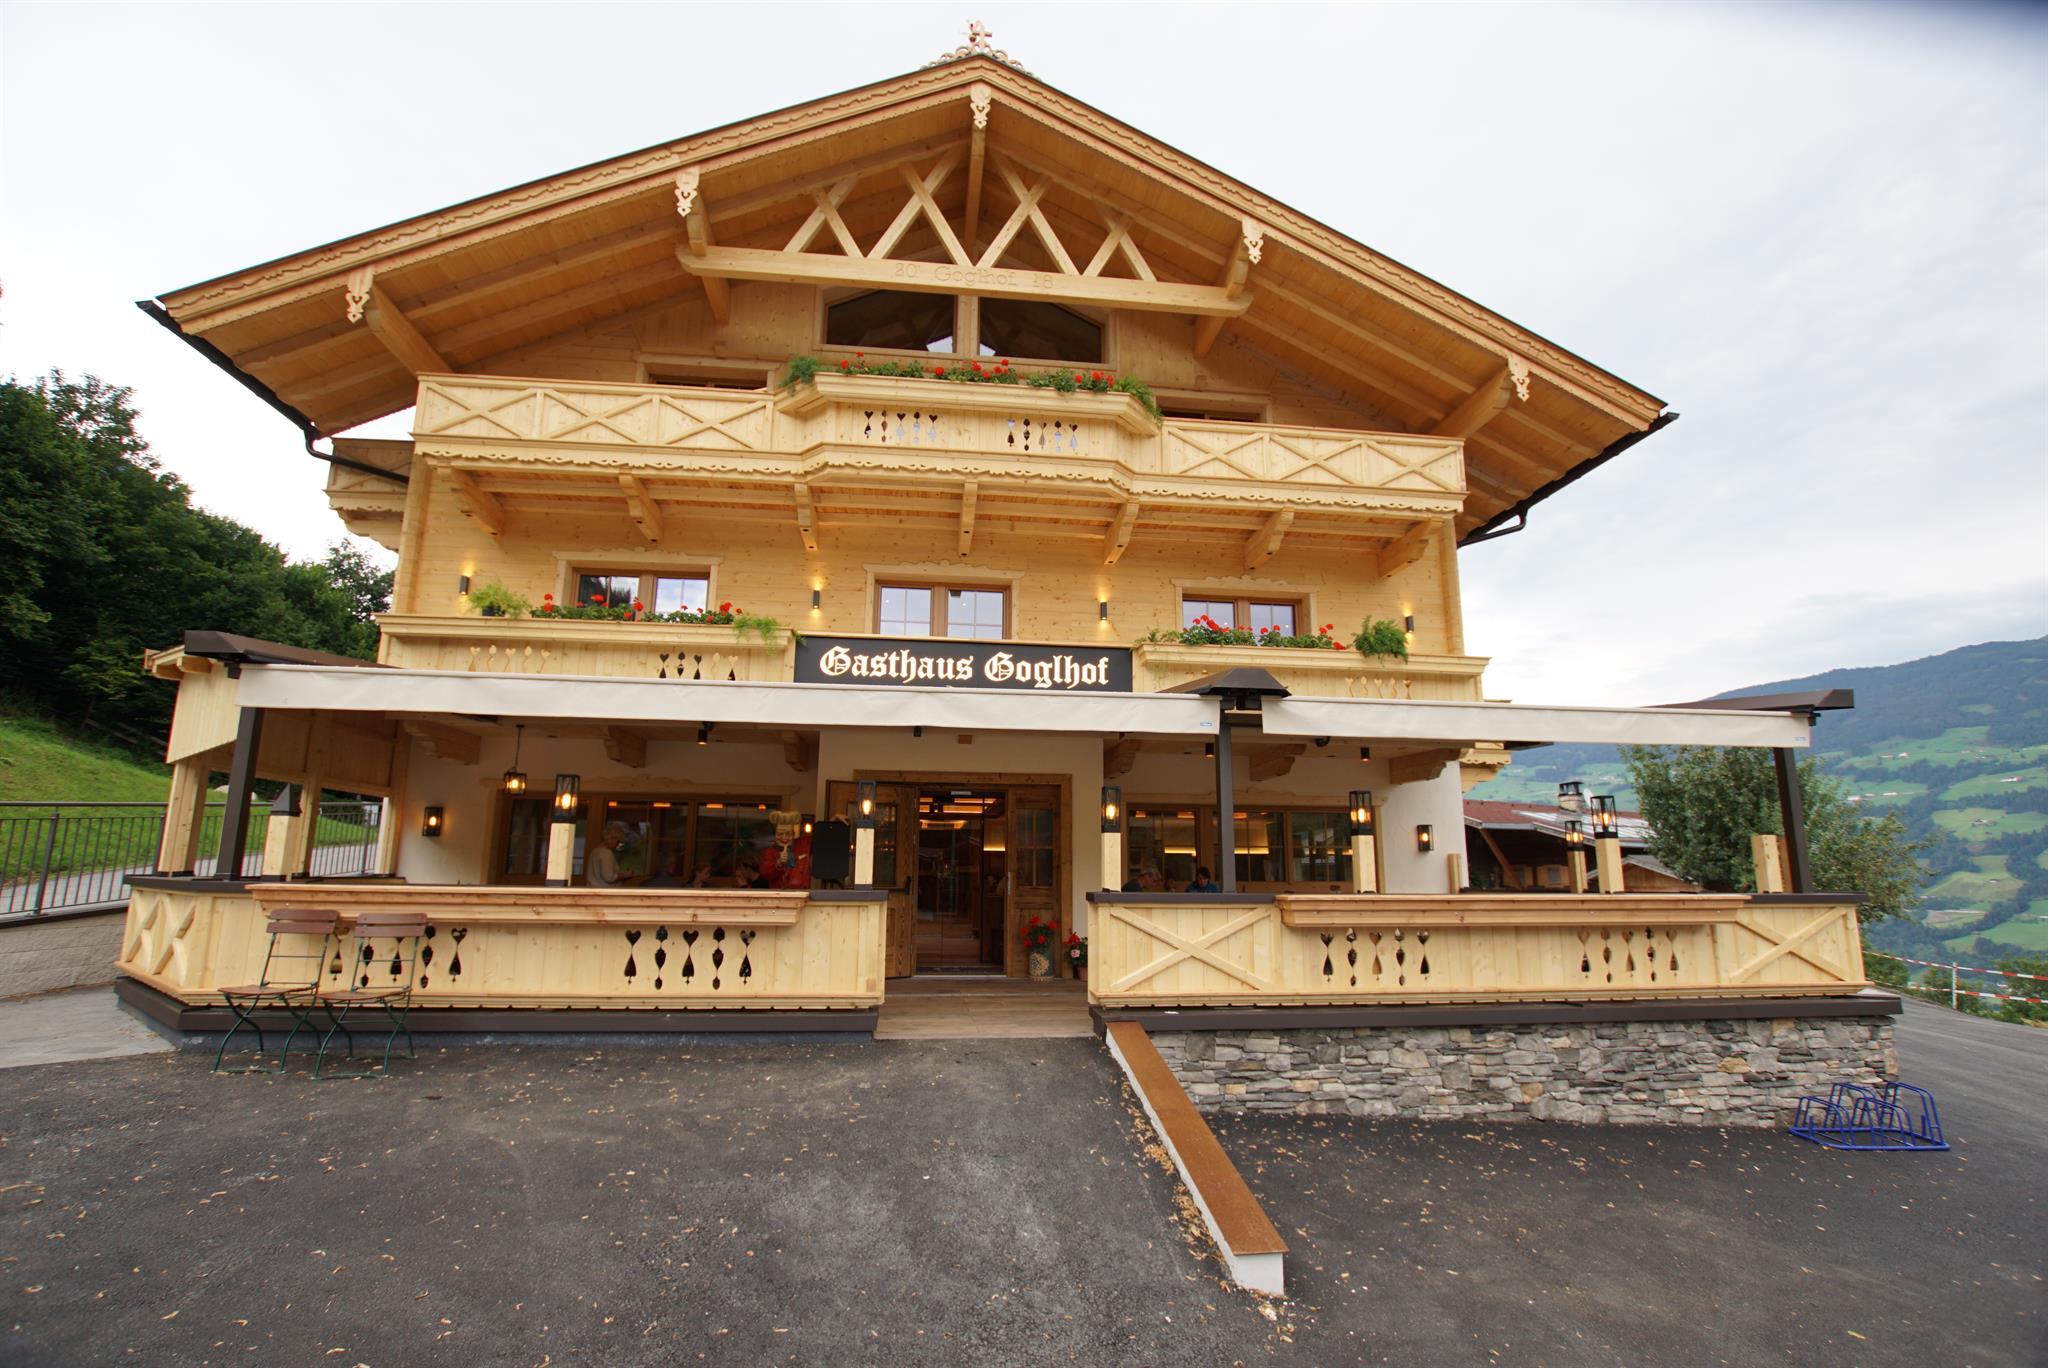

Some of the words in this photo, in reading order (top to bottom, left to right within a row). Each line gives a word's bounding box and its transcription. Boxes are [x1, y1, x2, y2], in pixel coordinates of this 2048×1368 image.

[934, 266, 1018, 286] Goglhof
[818, 645, 974, 683] Gasthaus
[984, 651, 1110, 689] Goglhof
